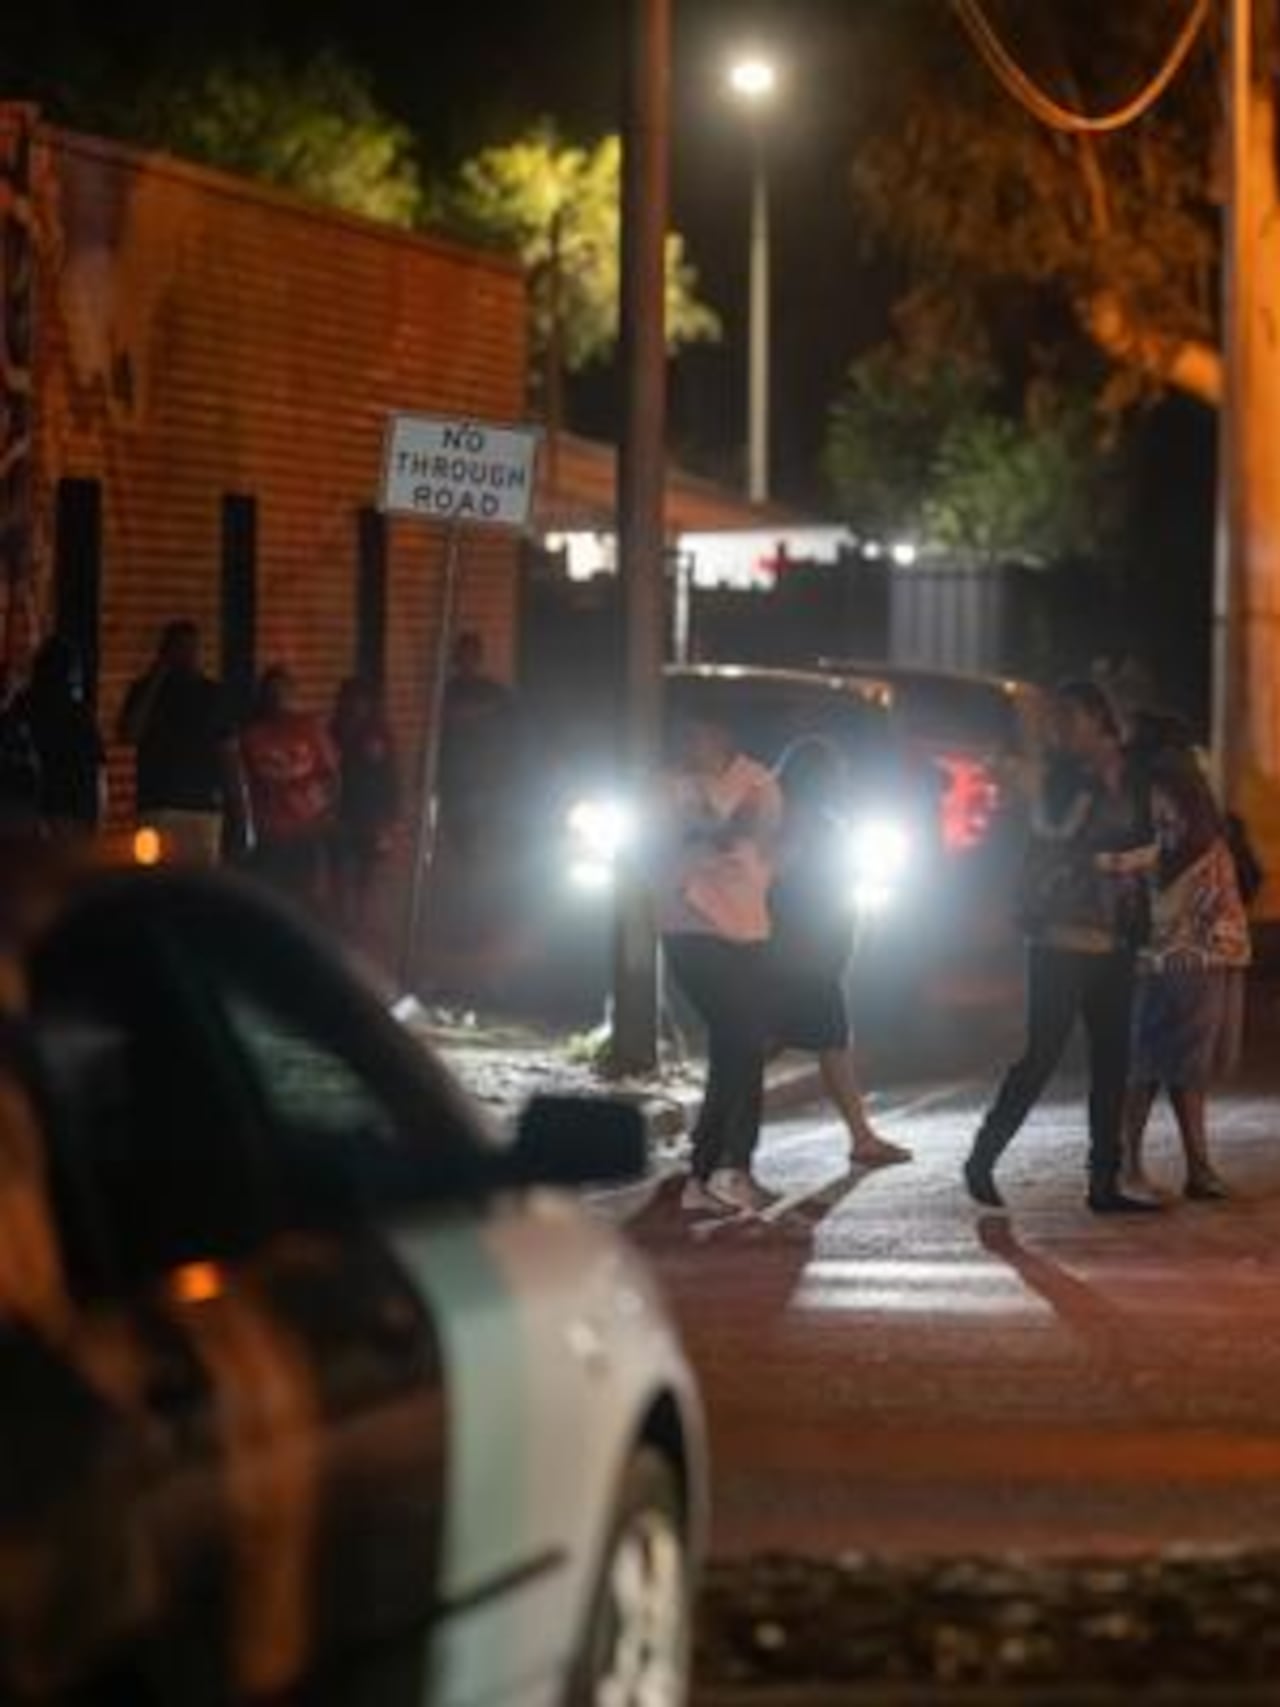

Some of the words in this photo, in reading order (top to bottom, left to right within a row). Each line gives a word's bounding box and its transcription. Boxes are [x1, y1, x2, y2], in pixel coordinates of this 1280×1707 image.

[442, 427, 485, 452] NO
[398, 452, 526, 488] THROUGH
[413, 485, 500, 516] ROAD
